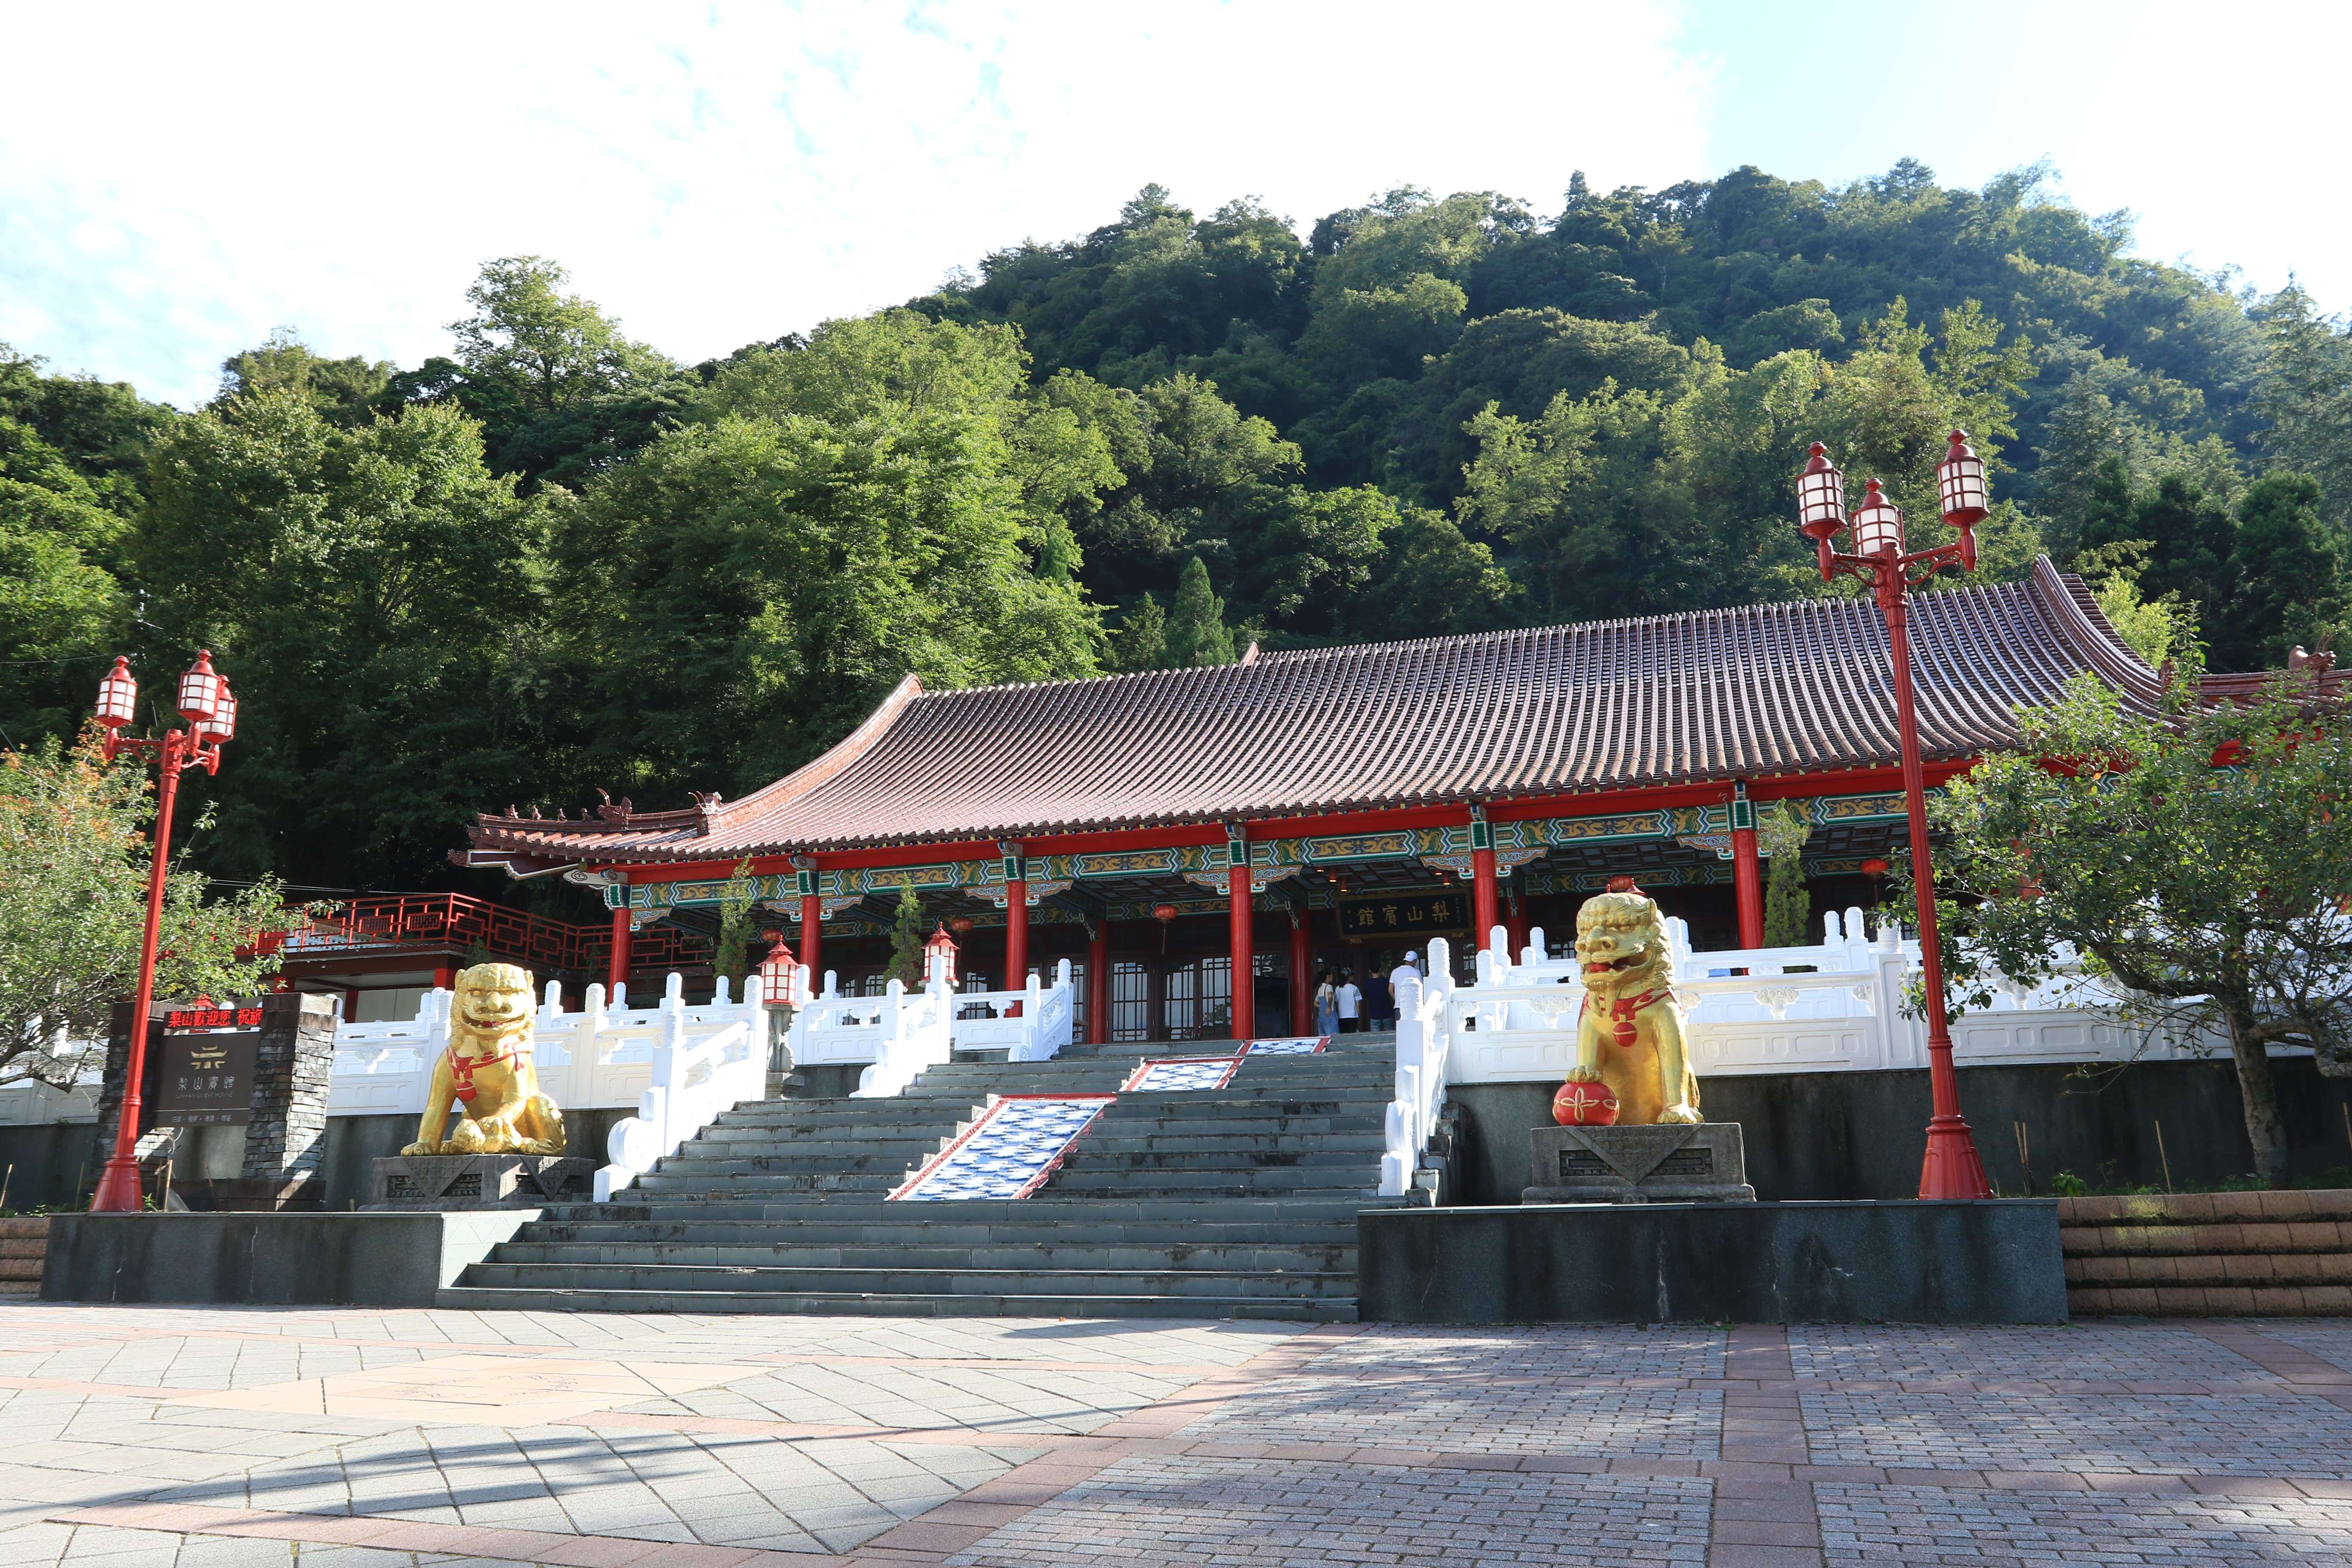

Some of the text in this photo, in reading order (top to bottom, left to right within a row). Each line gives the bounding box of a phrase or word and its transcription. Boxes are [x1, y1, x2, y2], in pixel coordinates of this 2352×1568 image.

[168, 1010, 231, 1027] 梨山歡迎您
[178, 1076, 235, 1091] 梨山賓館
